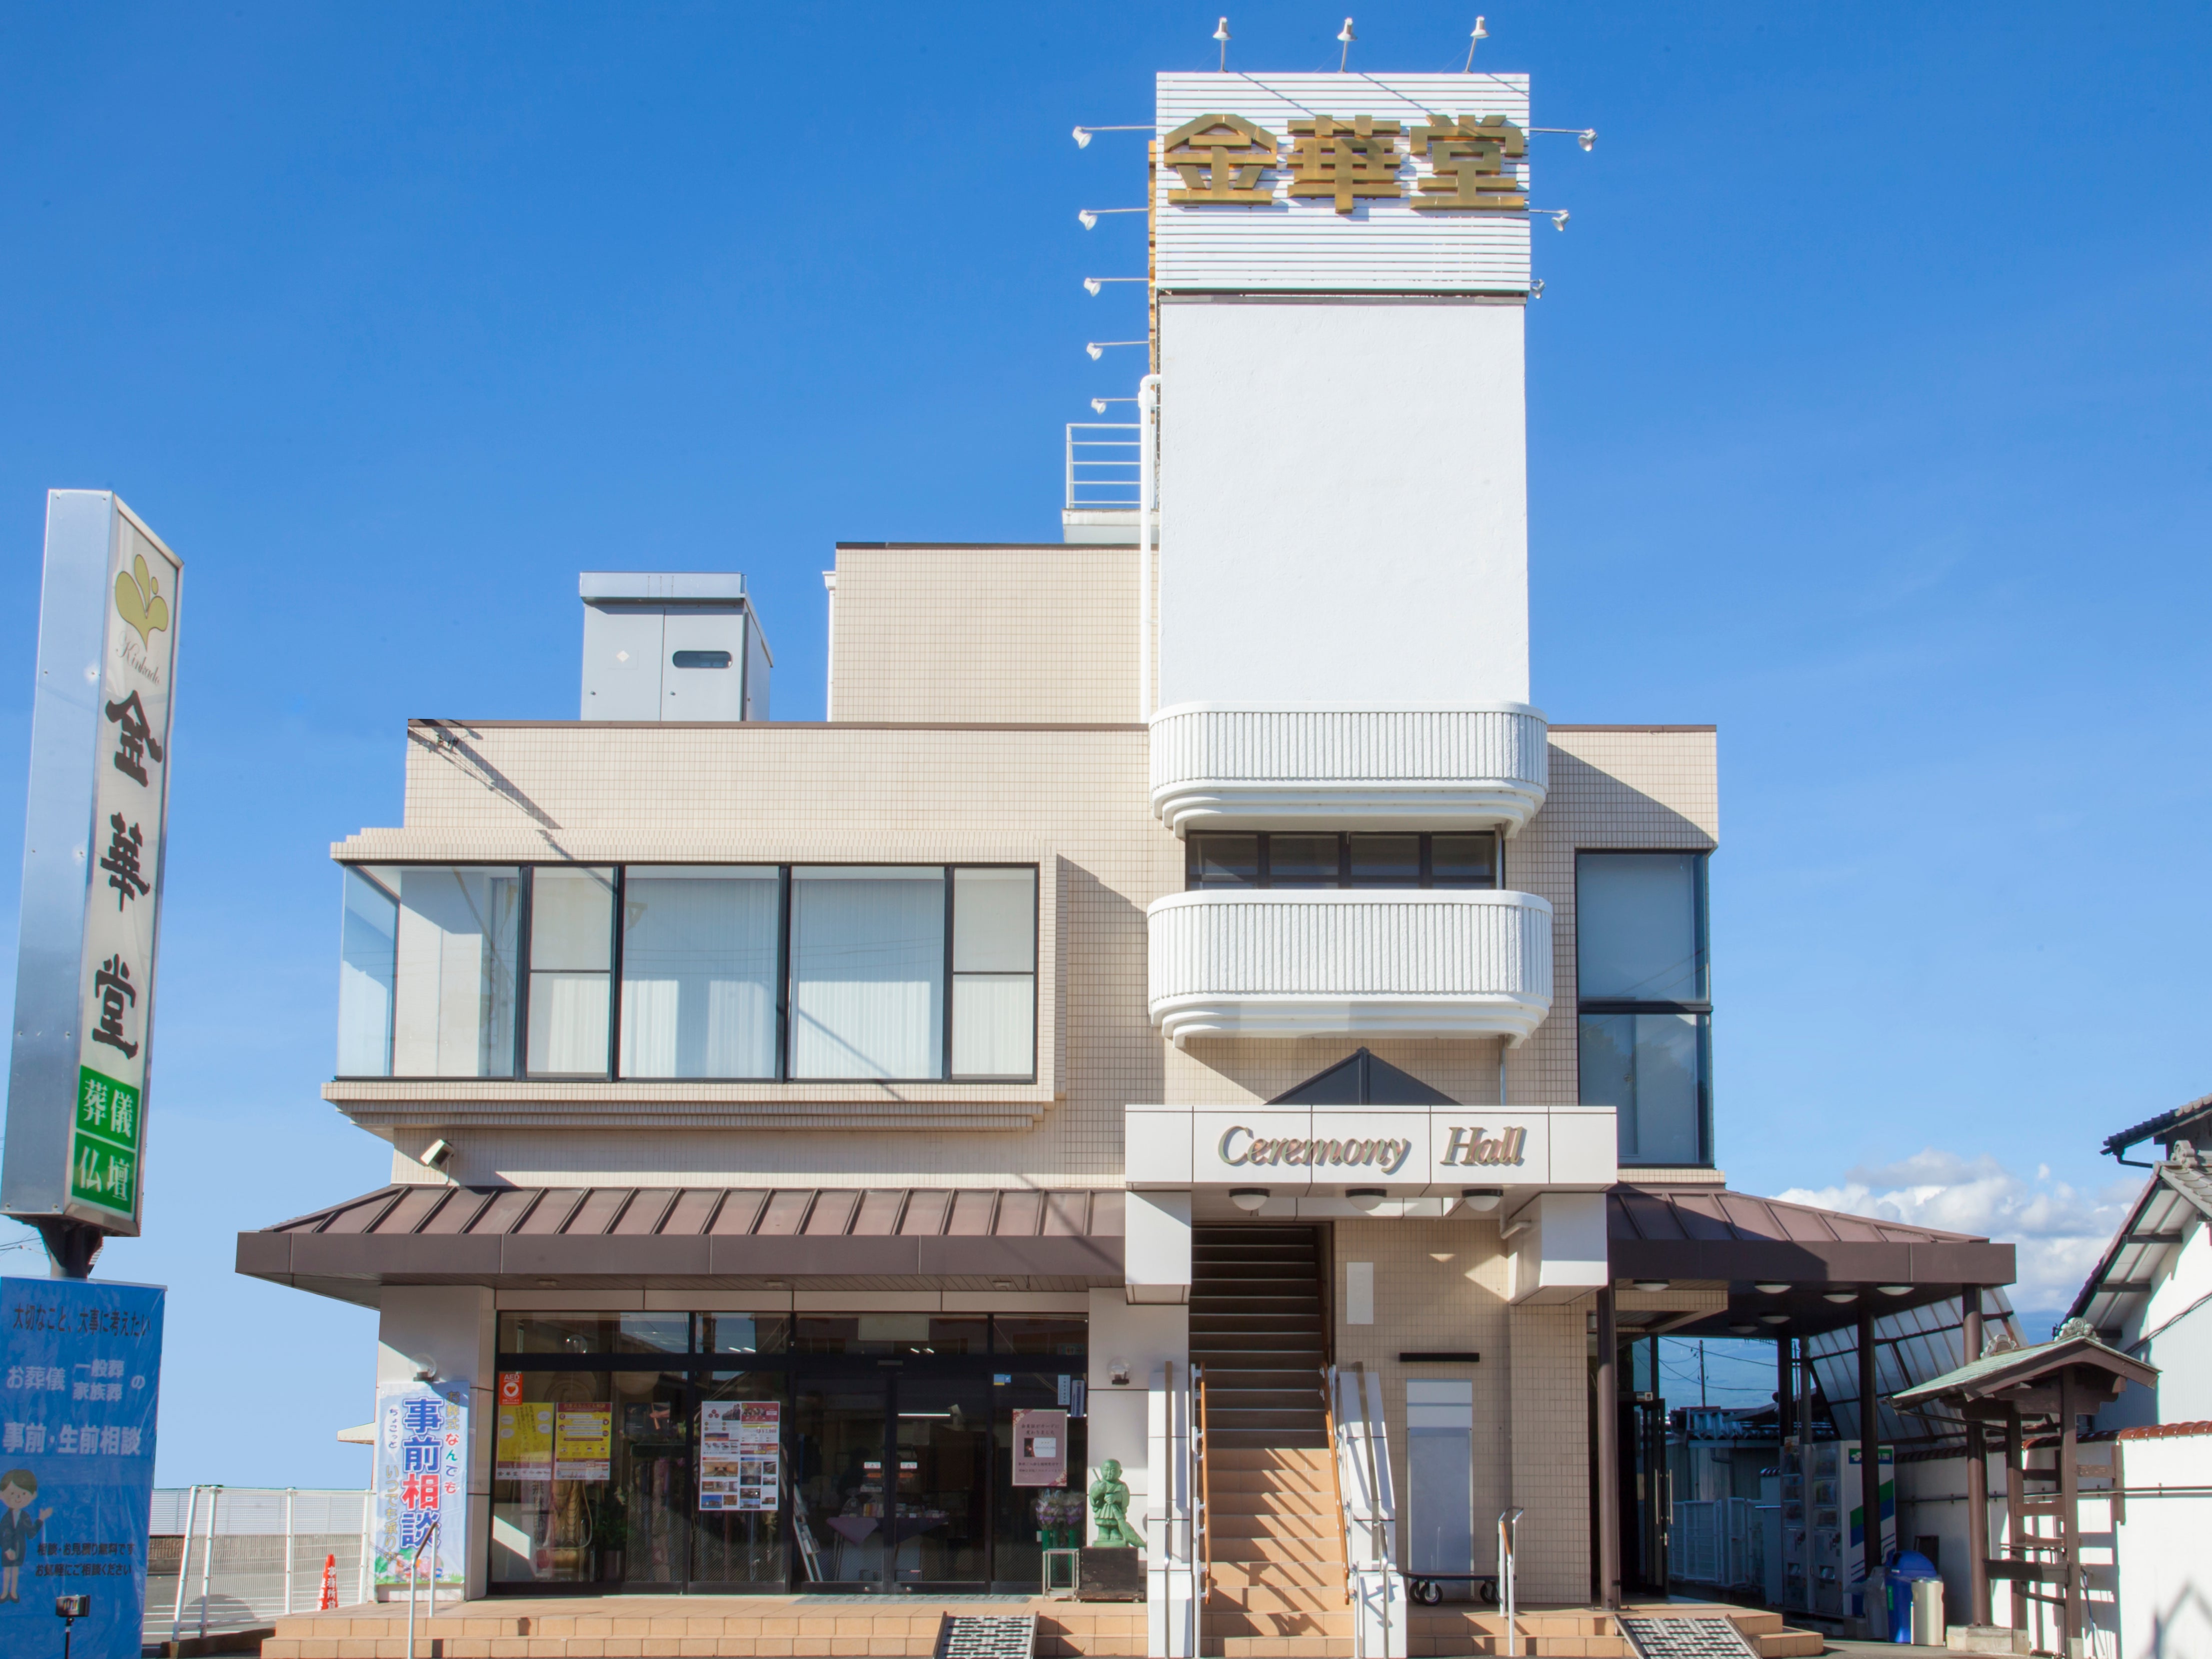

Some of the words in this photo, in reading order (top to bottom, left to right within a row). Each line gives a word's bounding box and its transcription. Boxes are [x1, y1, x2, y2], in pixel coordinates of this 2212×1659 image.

[1164, 114, 1524, 214] 金華堂
[116, 631, 160, 686] Kinkado
[92, 690, 163, 1060] 金華堂
[83, 1078, 134, 1138] 葬儀
[78, 1145, 130, 1201] 仏壇
[1217, 1125, 1408, 1174] Ceremony
[1439, 1125, 1527, 1166] Hall
[13, 1302, 151, 1337] 大切なこと、大事に考えたい
[6, 1365, 66, 1391] お葬儀
[75, 1358, 125, 1378] 一般葬
[131, 1375, 146, 1389] の
[73, 1381, 123, 1401] 家族葬
[3, 1421, 142, 1455] 事前・生前相談
[389, 1408, 399, 1448] ちょこっと
[401, 1396, 445, 1549] 事前相談
[384, 1465, 399, 1564] いつでも承り中
[36, 1563, 132, 1576] お気軽にご相談ください
